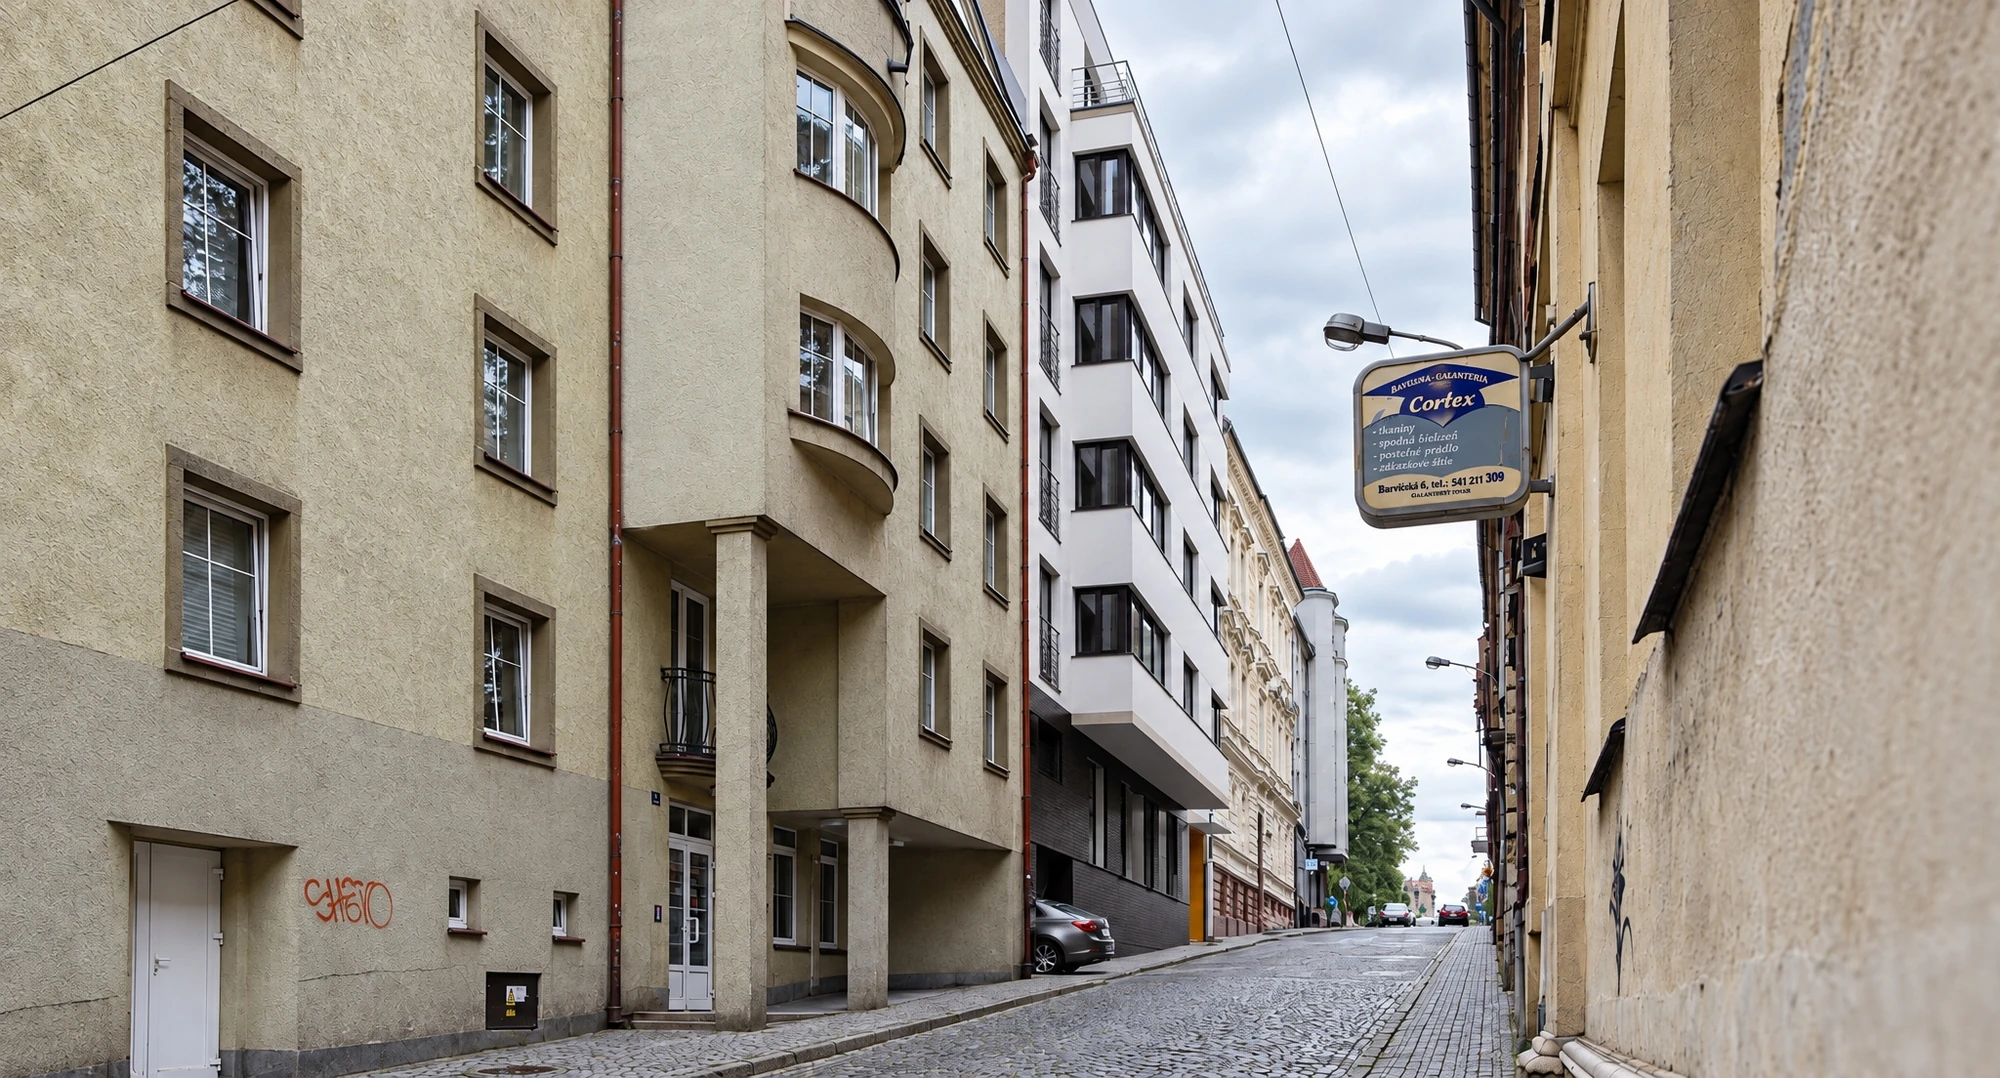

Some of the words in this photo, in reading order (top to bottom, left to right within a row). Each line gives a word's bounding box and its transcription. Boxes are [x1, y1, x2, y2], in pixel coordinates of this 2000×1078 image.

[1409, 391, 1476, 413] Cortex
[1379, 424, 1415, 435] tkaniny
[1420, 480, 1429, 490] 6,
[1431, 479, 1449, 489] tel.:
[1451, 477, 1467, 487] 541
[1469, 475, 1483, 485] 211
[1485, 471, 1505, 483] 309
